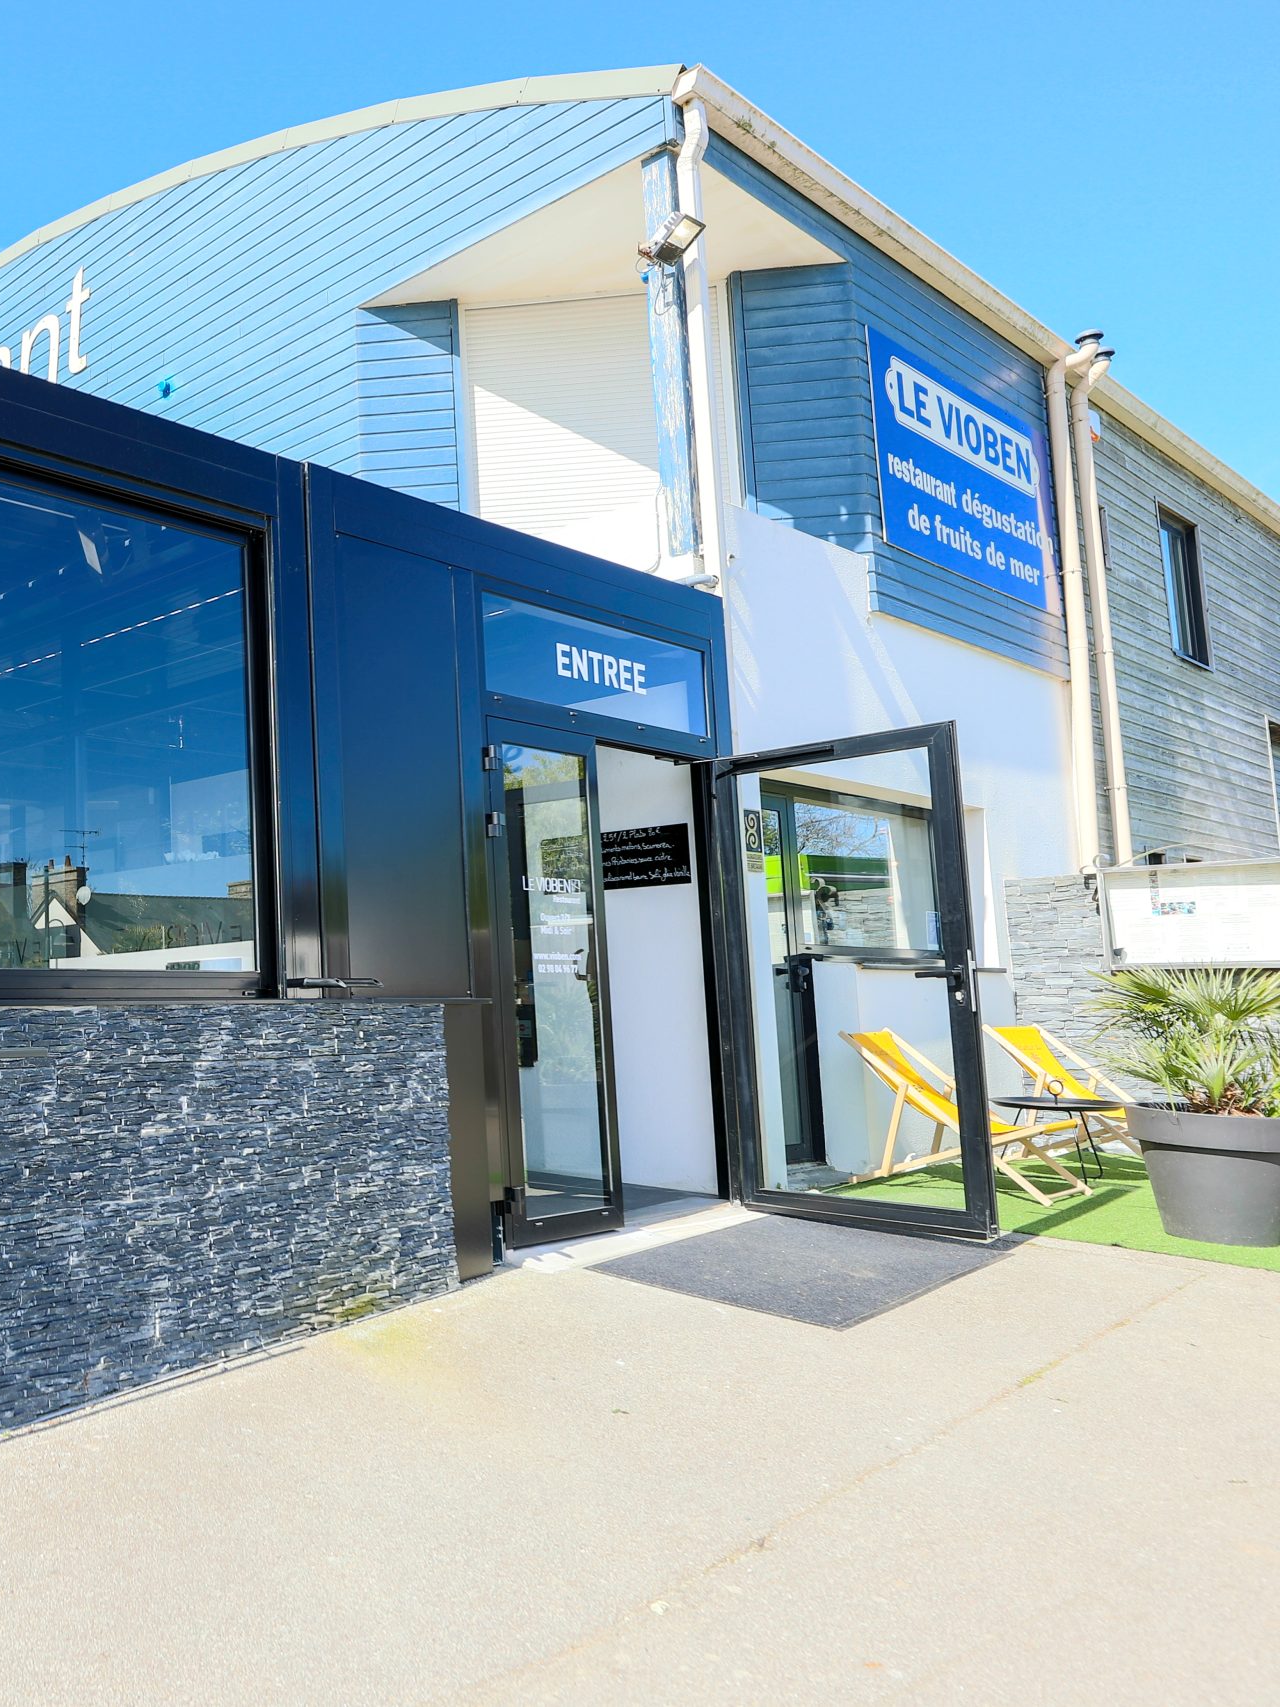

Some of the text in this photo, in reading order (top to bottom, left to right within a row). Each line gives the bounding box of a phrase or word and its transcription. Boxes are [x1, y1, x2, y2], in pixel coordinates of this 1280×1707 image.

[896, 371, 1032, 485] LE VIOBEN
[887, 453, 1054, 556] restaurant dégustation
[907, 503, 1040, 586] de fruits de mer
[555, 642, 647, 695] ENTREE
[522, 875, 571, 893] LE VIOBEN
